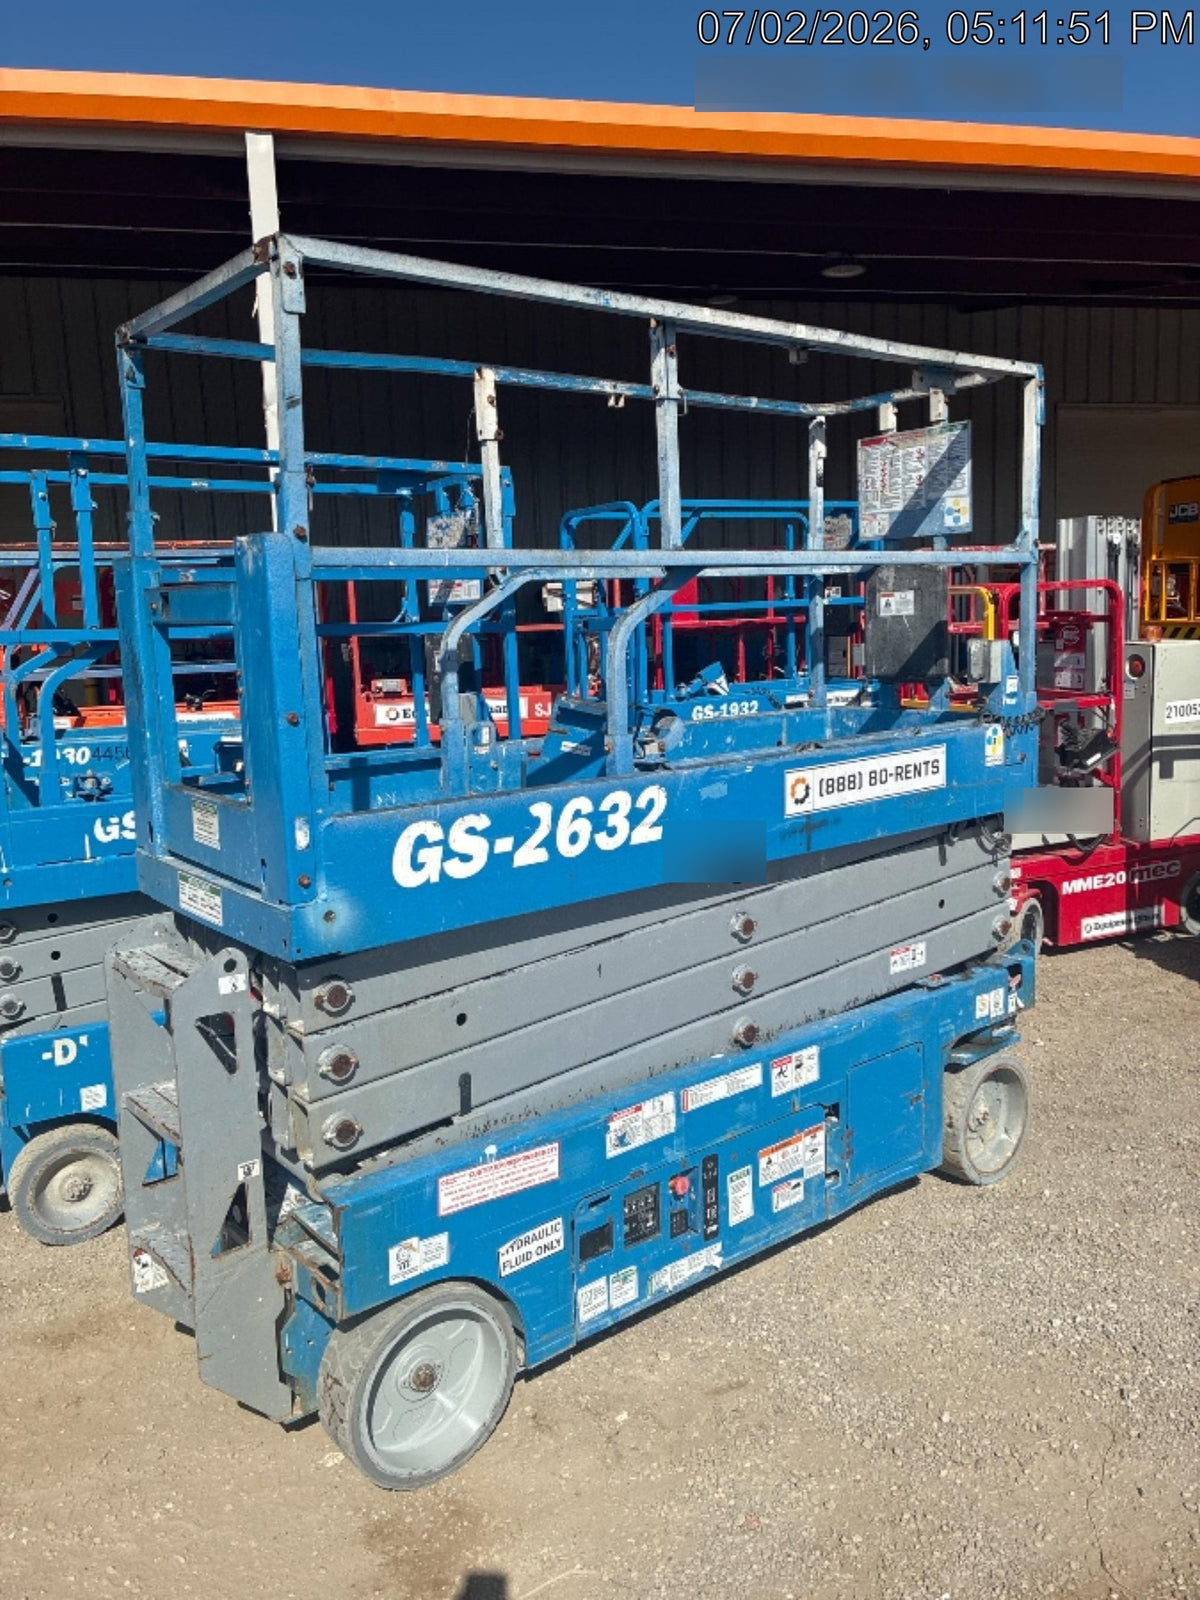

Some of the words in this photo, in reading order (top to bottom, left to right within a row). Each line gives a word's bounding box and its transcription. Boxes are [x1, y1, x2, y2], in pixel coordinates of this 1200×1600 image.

[1169, 503, 1199, 518] JCB
[692, 700, 759, 721] GS-1932
[819, 771, 863, 797] (888)
[869, 759, 940, 786] 80-RENTS
[392, 785, 667, 888] GS-2632
[1062, 871, 1127, 895] MME20
[501, 1221, 561, 1257] YDRAULIC
[503, 1251, 533, 1272] FLUID
[535, 1236, 562, 1256] ONLY
